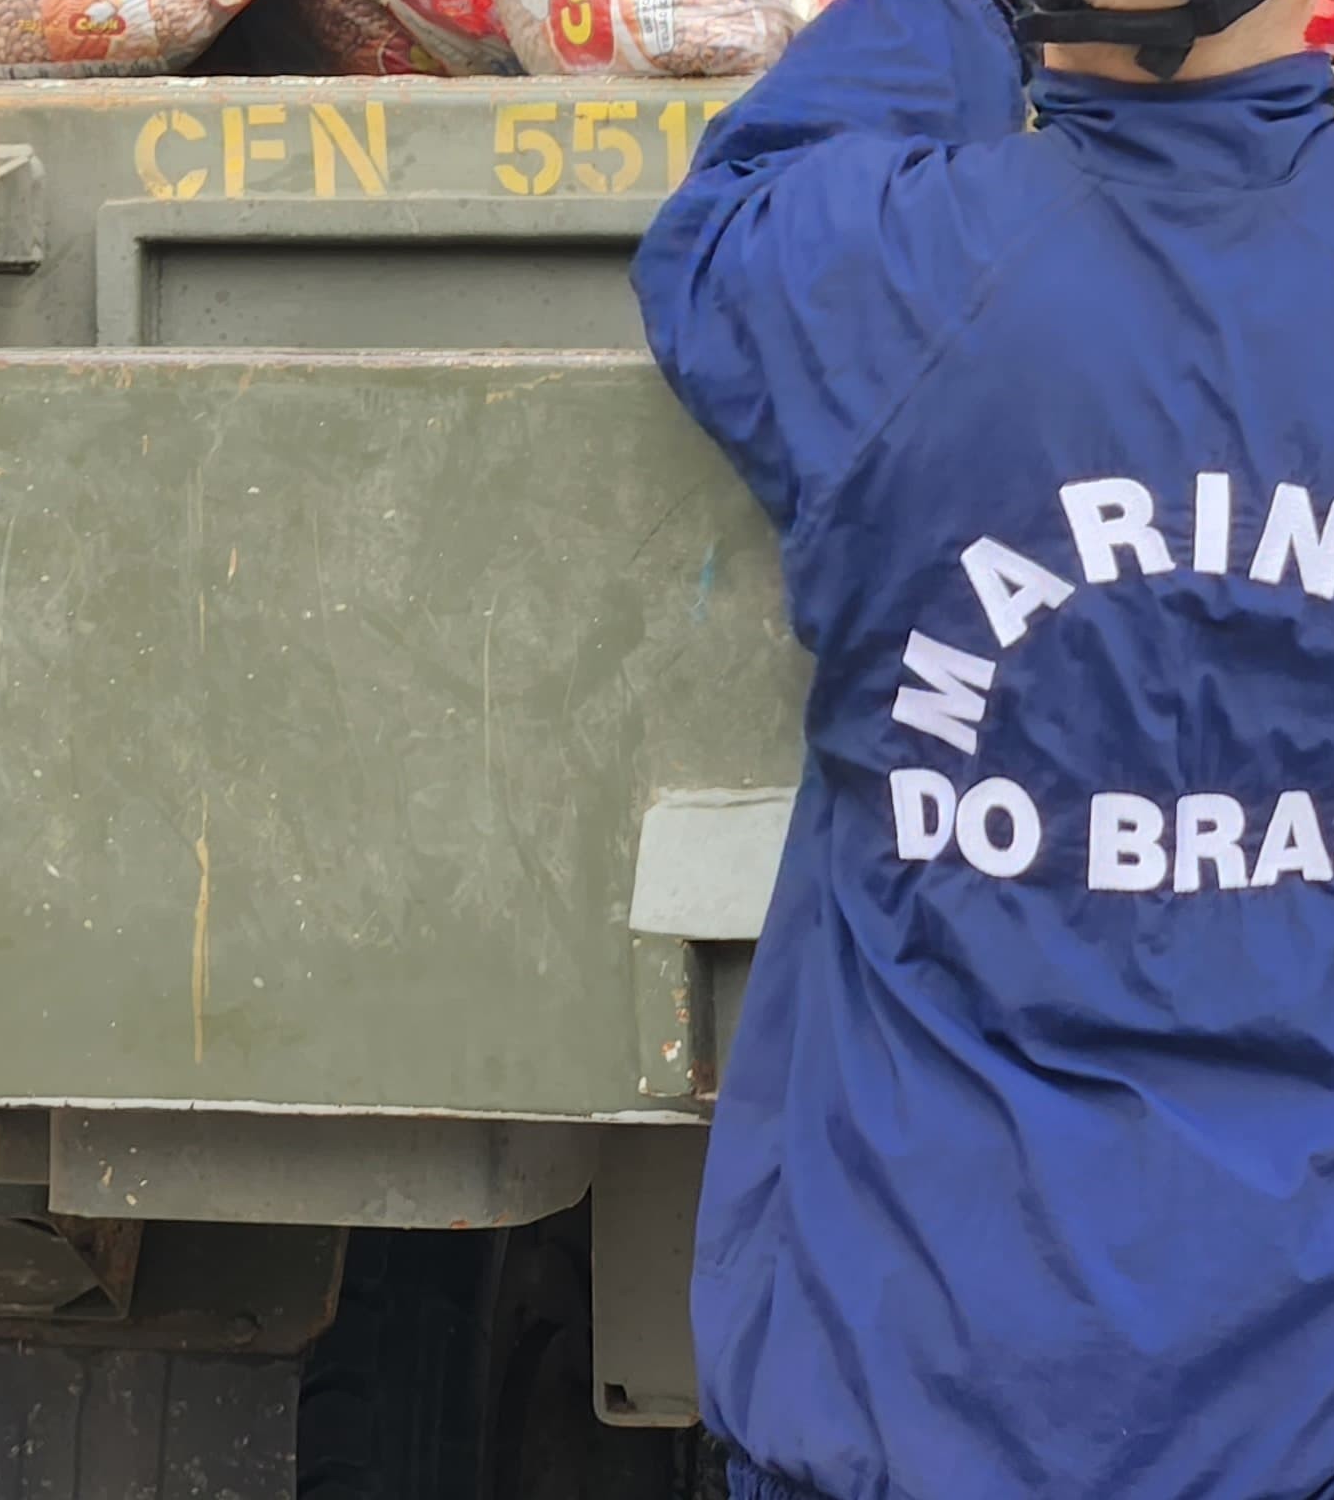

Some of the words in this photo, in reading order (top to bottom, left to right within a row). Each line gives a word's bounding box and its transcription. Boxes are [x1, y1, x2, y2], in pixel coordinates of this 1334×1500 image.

[135, 101, 389, 199] CFN
[493, 101, 730, 196] 551
[889, 768, 1041, 878] DO
